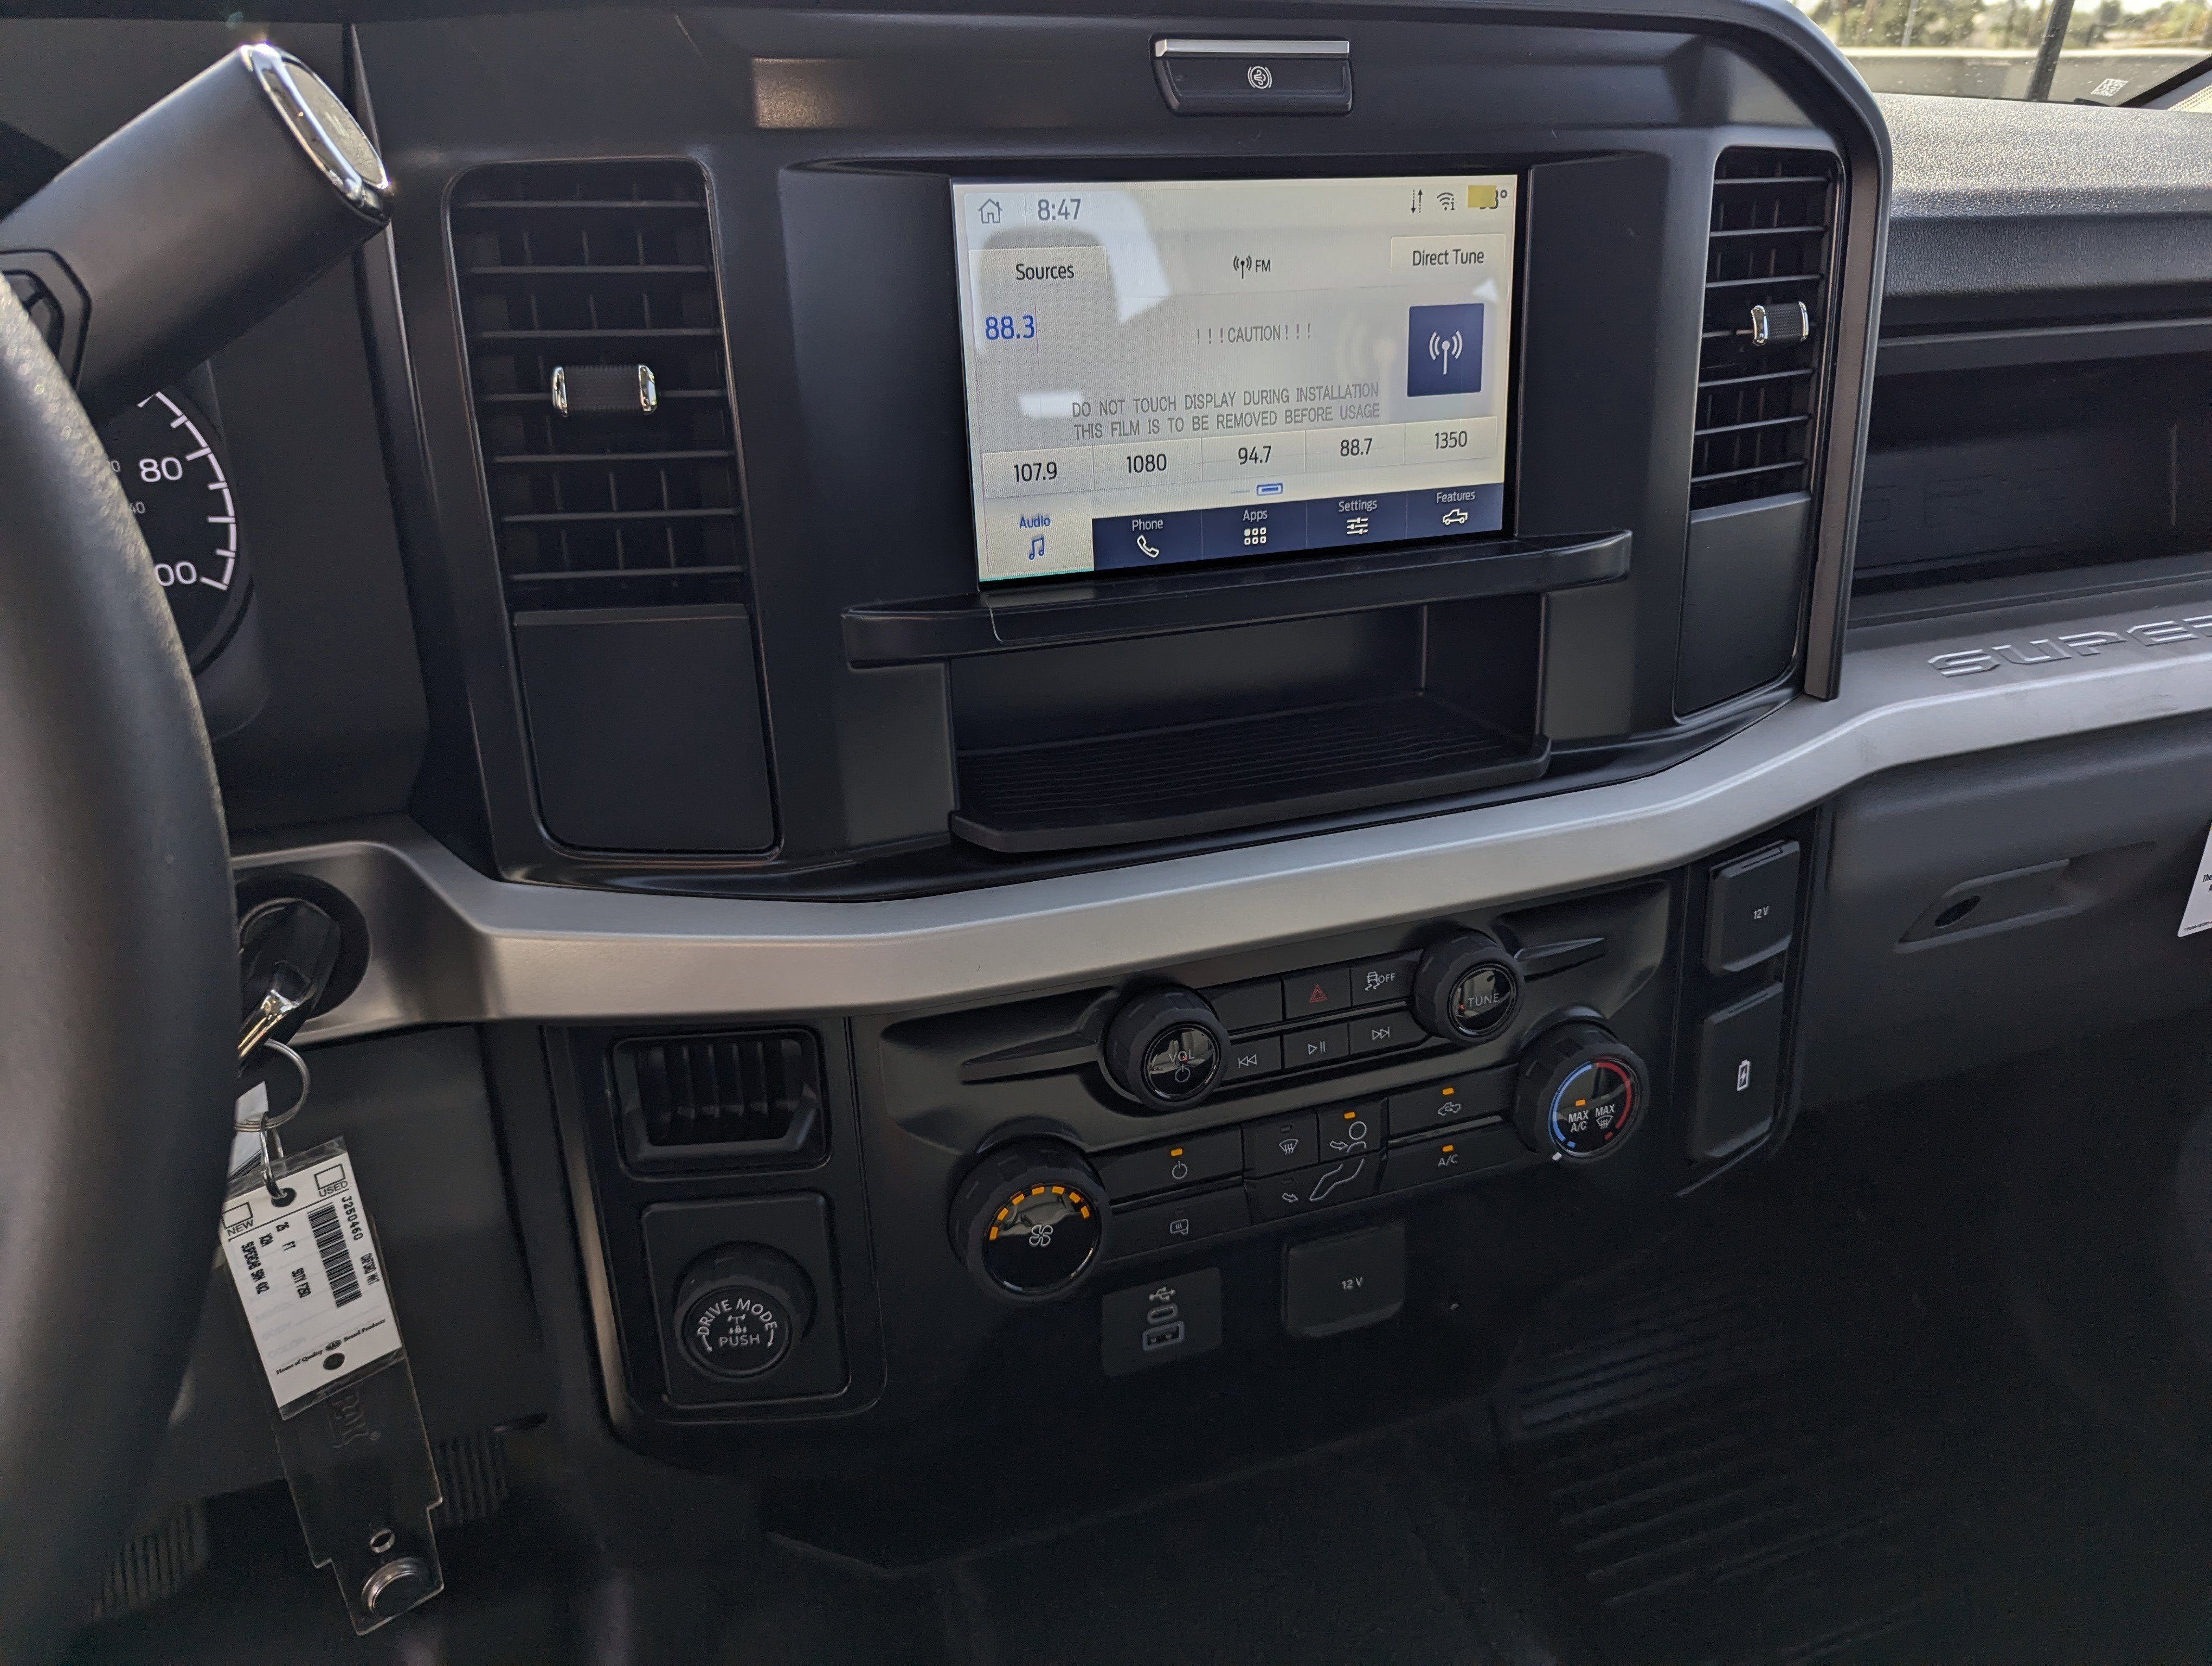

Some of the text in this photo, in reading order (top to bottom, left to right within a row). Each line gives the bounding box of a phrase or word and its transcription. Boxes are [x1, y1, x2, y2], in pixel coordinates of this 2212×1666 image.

[1038, 198, 1081, 221] 8:47
[1255, 259, 1271, 272] FM
[1412, 249, 1484, 266] Direct Tune
[1015, 264, 1075, 280] Sources
[985, 315, 1035, 341] 88.3
[1072, 382, 1379, 417] DO NOT TOUCH DISPLAY DURING INSTALLATION
[1074, 403, 1380, 440] THIS FILM IS TO BE REMOVED BEFORE USAGE
[1340, 438, 1373, 457] 88.7
[1435, 431, 1468, 450] 1350
[1126, 453, 1167, 474] 1080
[1238, 446, 1272, 465] 94.7
[138, 456, 183, 483] 80
[1014, 462, 1057, 483] 107.9
[1436, 490, 1476, 503] Features
[1339, 498, 1378, 512] Settings
[1019, 515, 1051, 529] Audio
[1243, 509, 1268, 522] Apps
[1131, 518, 1164, 532] Phone
[1378, 971, 1396, 984] OFF
[1467, 992, 1501, 1008] TUNE
[1168, 1049, 1195, 1063] VOL
[1568, 1110, 1589, 1123] MAX
[1596, 1103, 1616, 1117] MAX
[1570, 1120, 1587, 1133] A/C
[1437, 1155, 1459, 1167] A/C
[318, 1180, 348, 1198] USED
[341, 1195, 364, 1241] J250460
[227, 1219, 254, 1237] NEW
[697, 1298, 778, 1336] DRIVE MODE
[718, 1334, 761, 1348] PUSH
